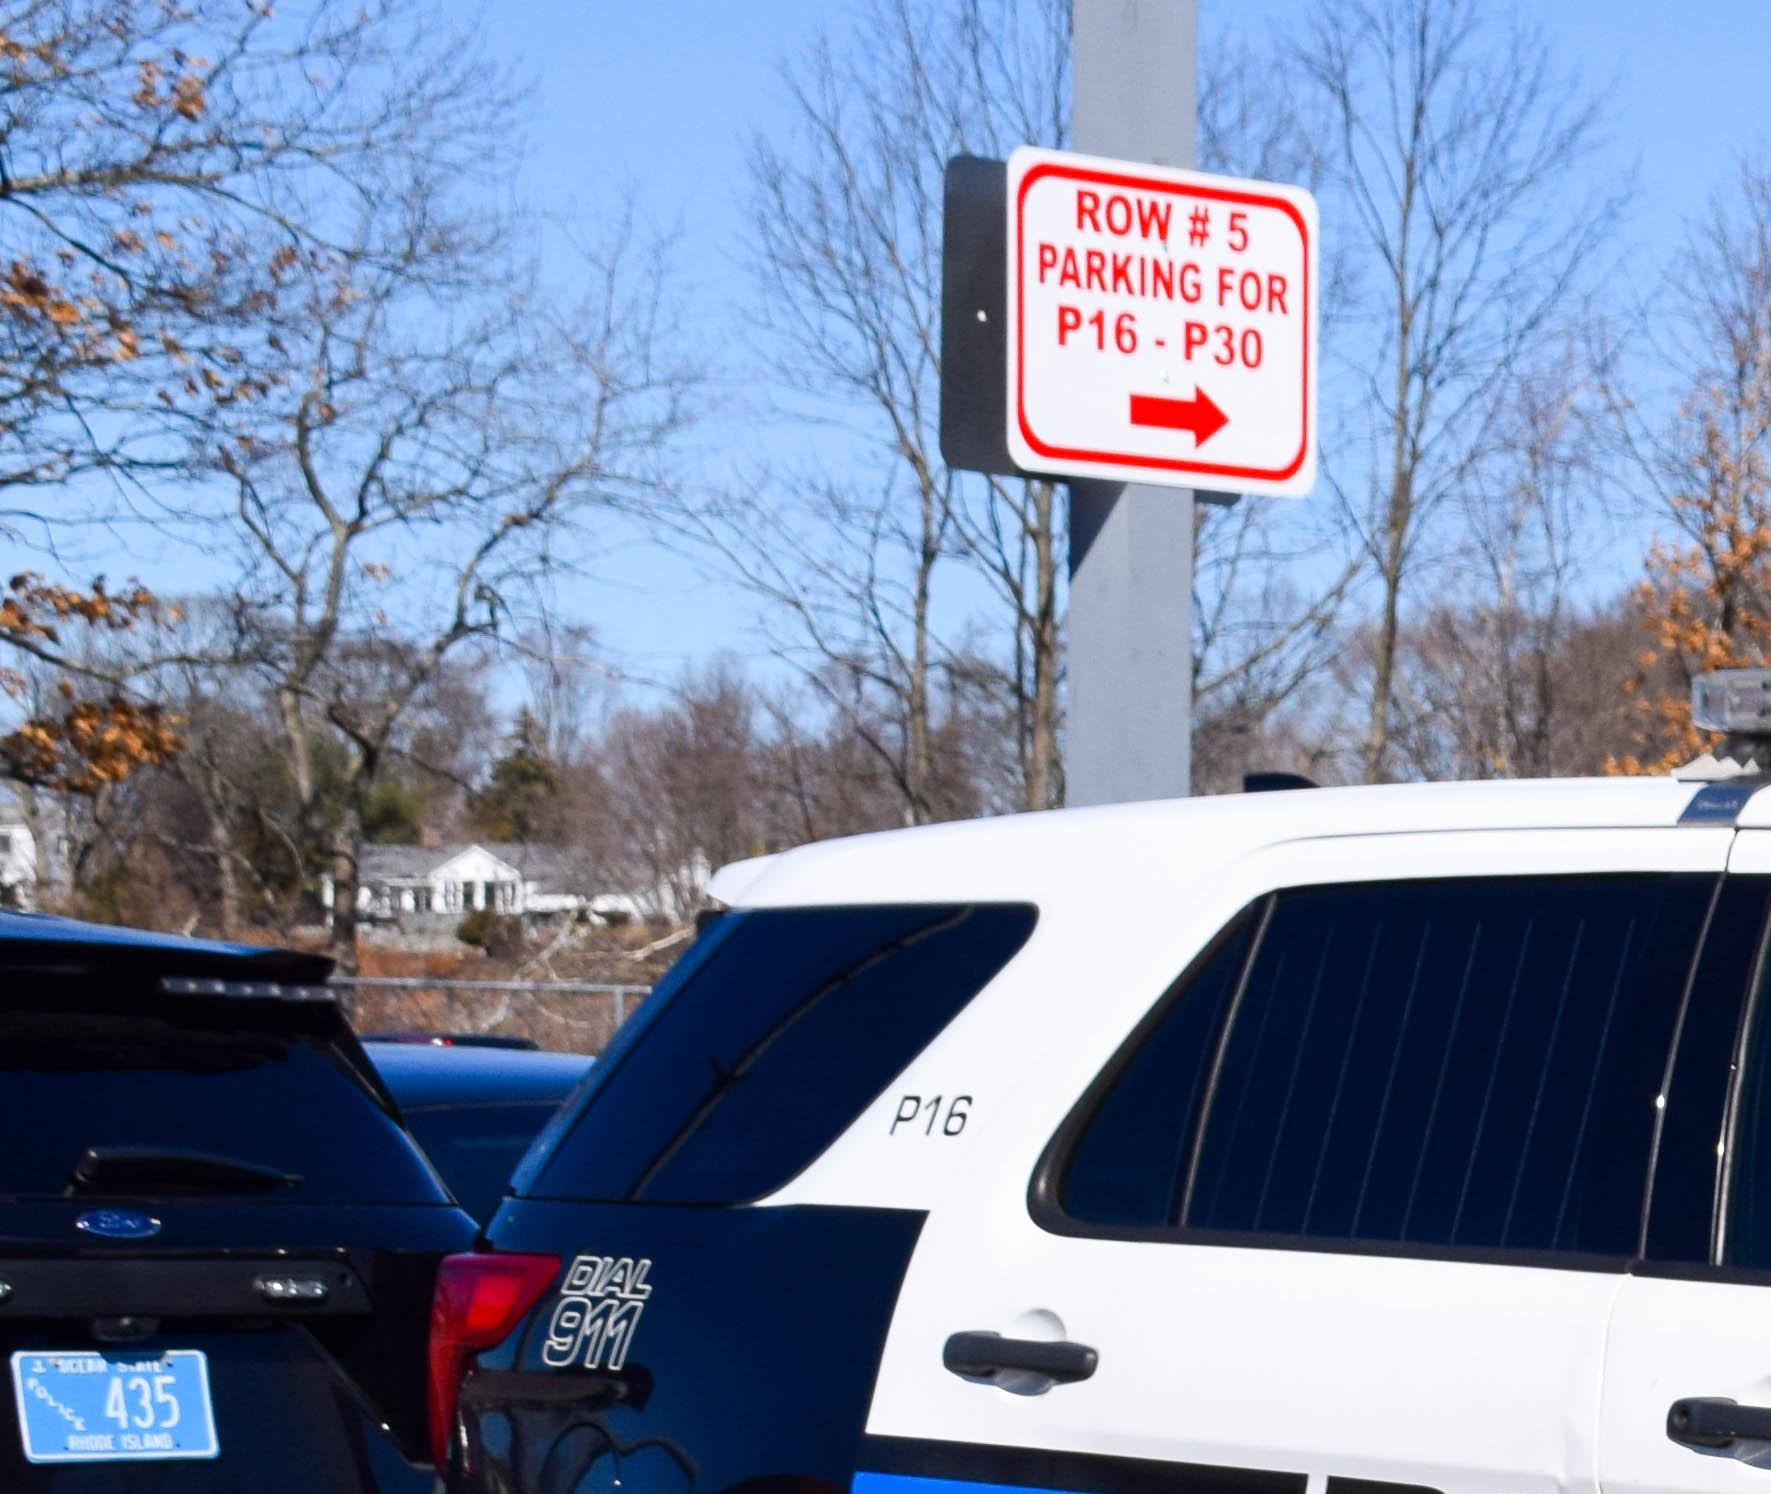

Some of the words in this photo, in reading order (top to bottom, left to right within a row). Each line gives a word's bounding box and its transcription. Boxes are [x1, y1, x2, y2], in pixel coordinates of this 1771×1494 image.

[1076, 190, 1172, 242] ROW
[1188, 207, 1210, 248] #
[1229, 212, 1248, 252] 5
[1039, 243, 1202, 304] PARKING
[1218, 268, 1289, 315] FOR
[1057, 305, 1138, 354] P16
[1184, 321, 1262, 370] P30
[888, 1094, 973, 1137] P16
[560, 1255, 652, 1299] DIAL
[542, 1296, 644, 1371] 911
[105, 1375, 181, 1429] 435
